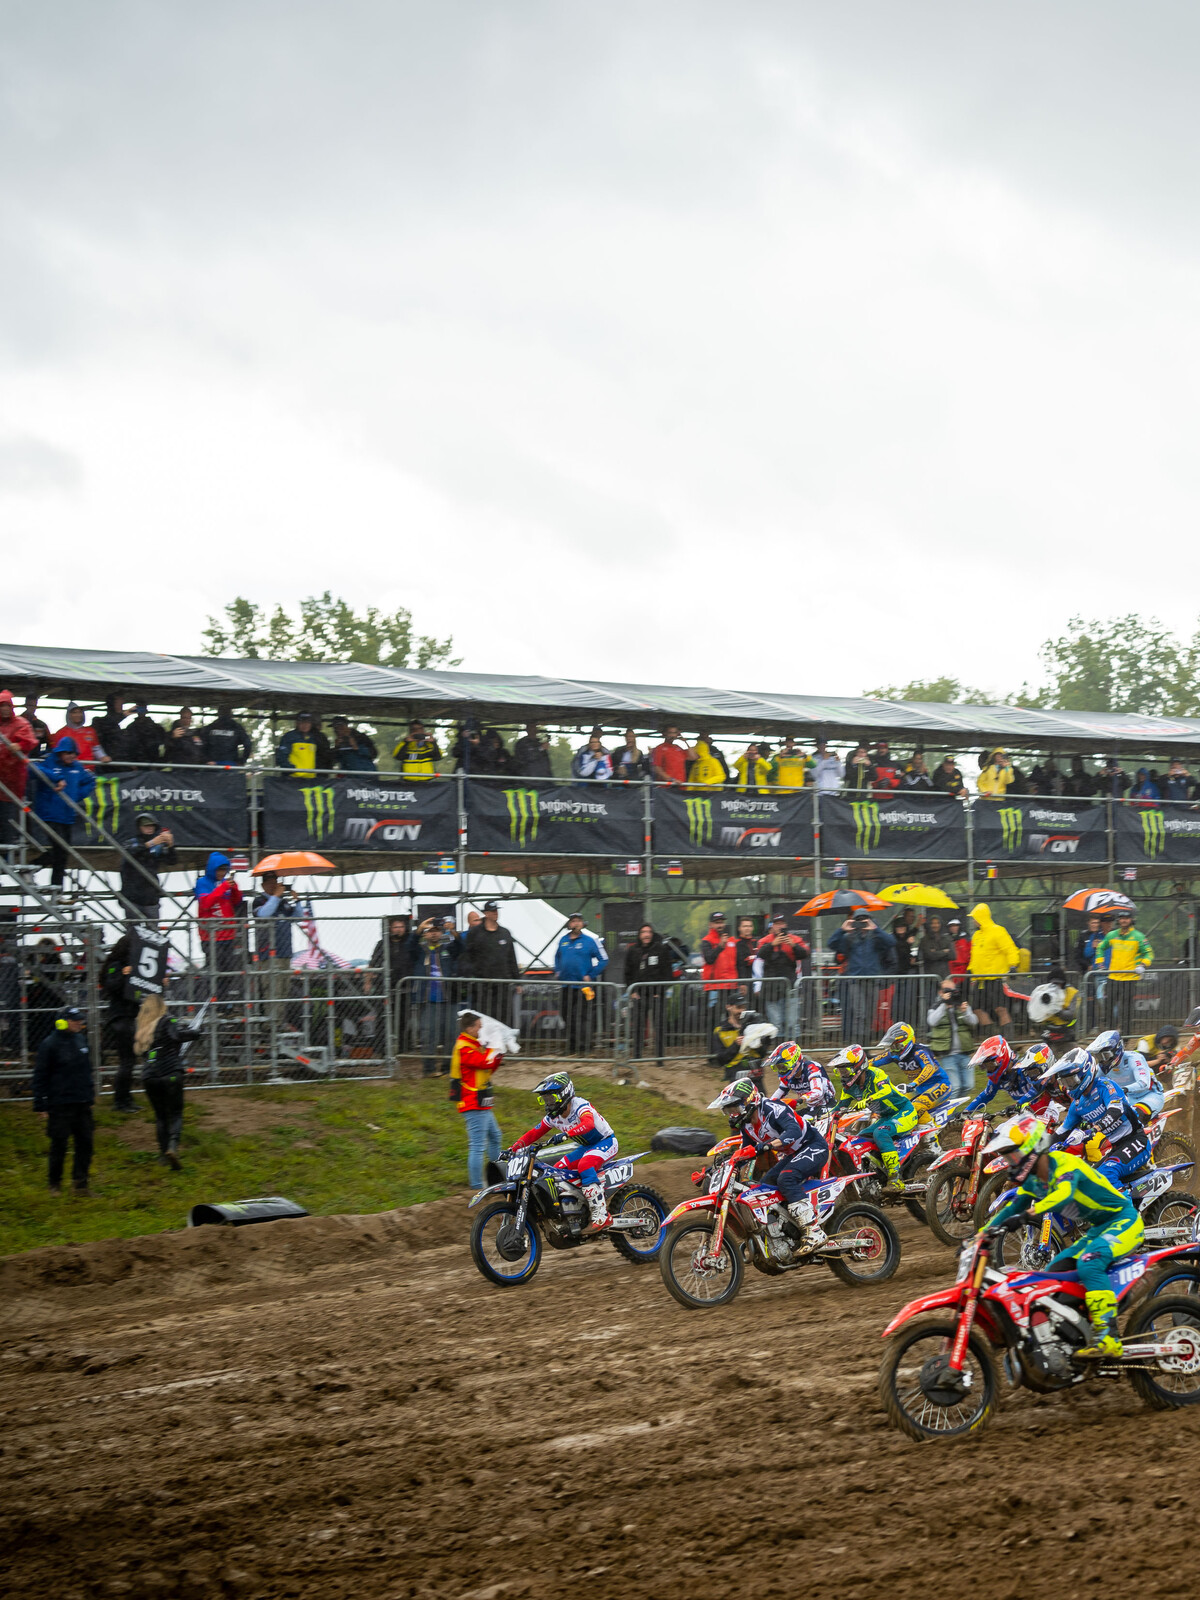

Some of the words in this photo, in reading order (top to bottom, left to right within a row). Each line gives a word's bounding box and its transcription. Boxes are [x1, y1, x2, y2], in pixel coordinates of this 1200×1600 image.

[121, 786, 205, 802] MONSTER
[347, 788, 418, 802] MONSTER
[539, 800, 608, 815] MONSTER
[720, 799, 779, 812] MONSTER
[879, 810, 937, 824] MONSTER
[1029, 809, 1077, 822] MONSTER
[138, 947, 159, 978] 5
[898, 1060, 919, 1071] FXR
[932, 1083, 949, 1099] FXR
[934, 1110, 948, 1125] 57
[964, 1124, 978, 1139] 2
[904, 1134, 920, 1149] 114
[605, 1166, 630, 1185] 102
[817, 1189, 831, 1203] 9
[1118, 1259, 1145, 1285] 115
